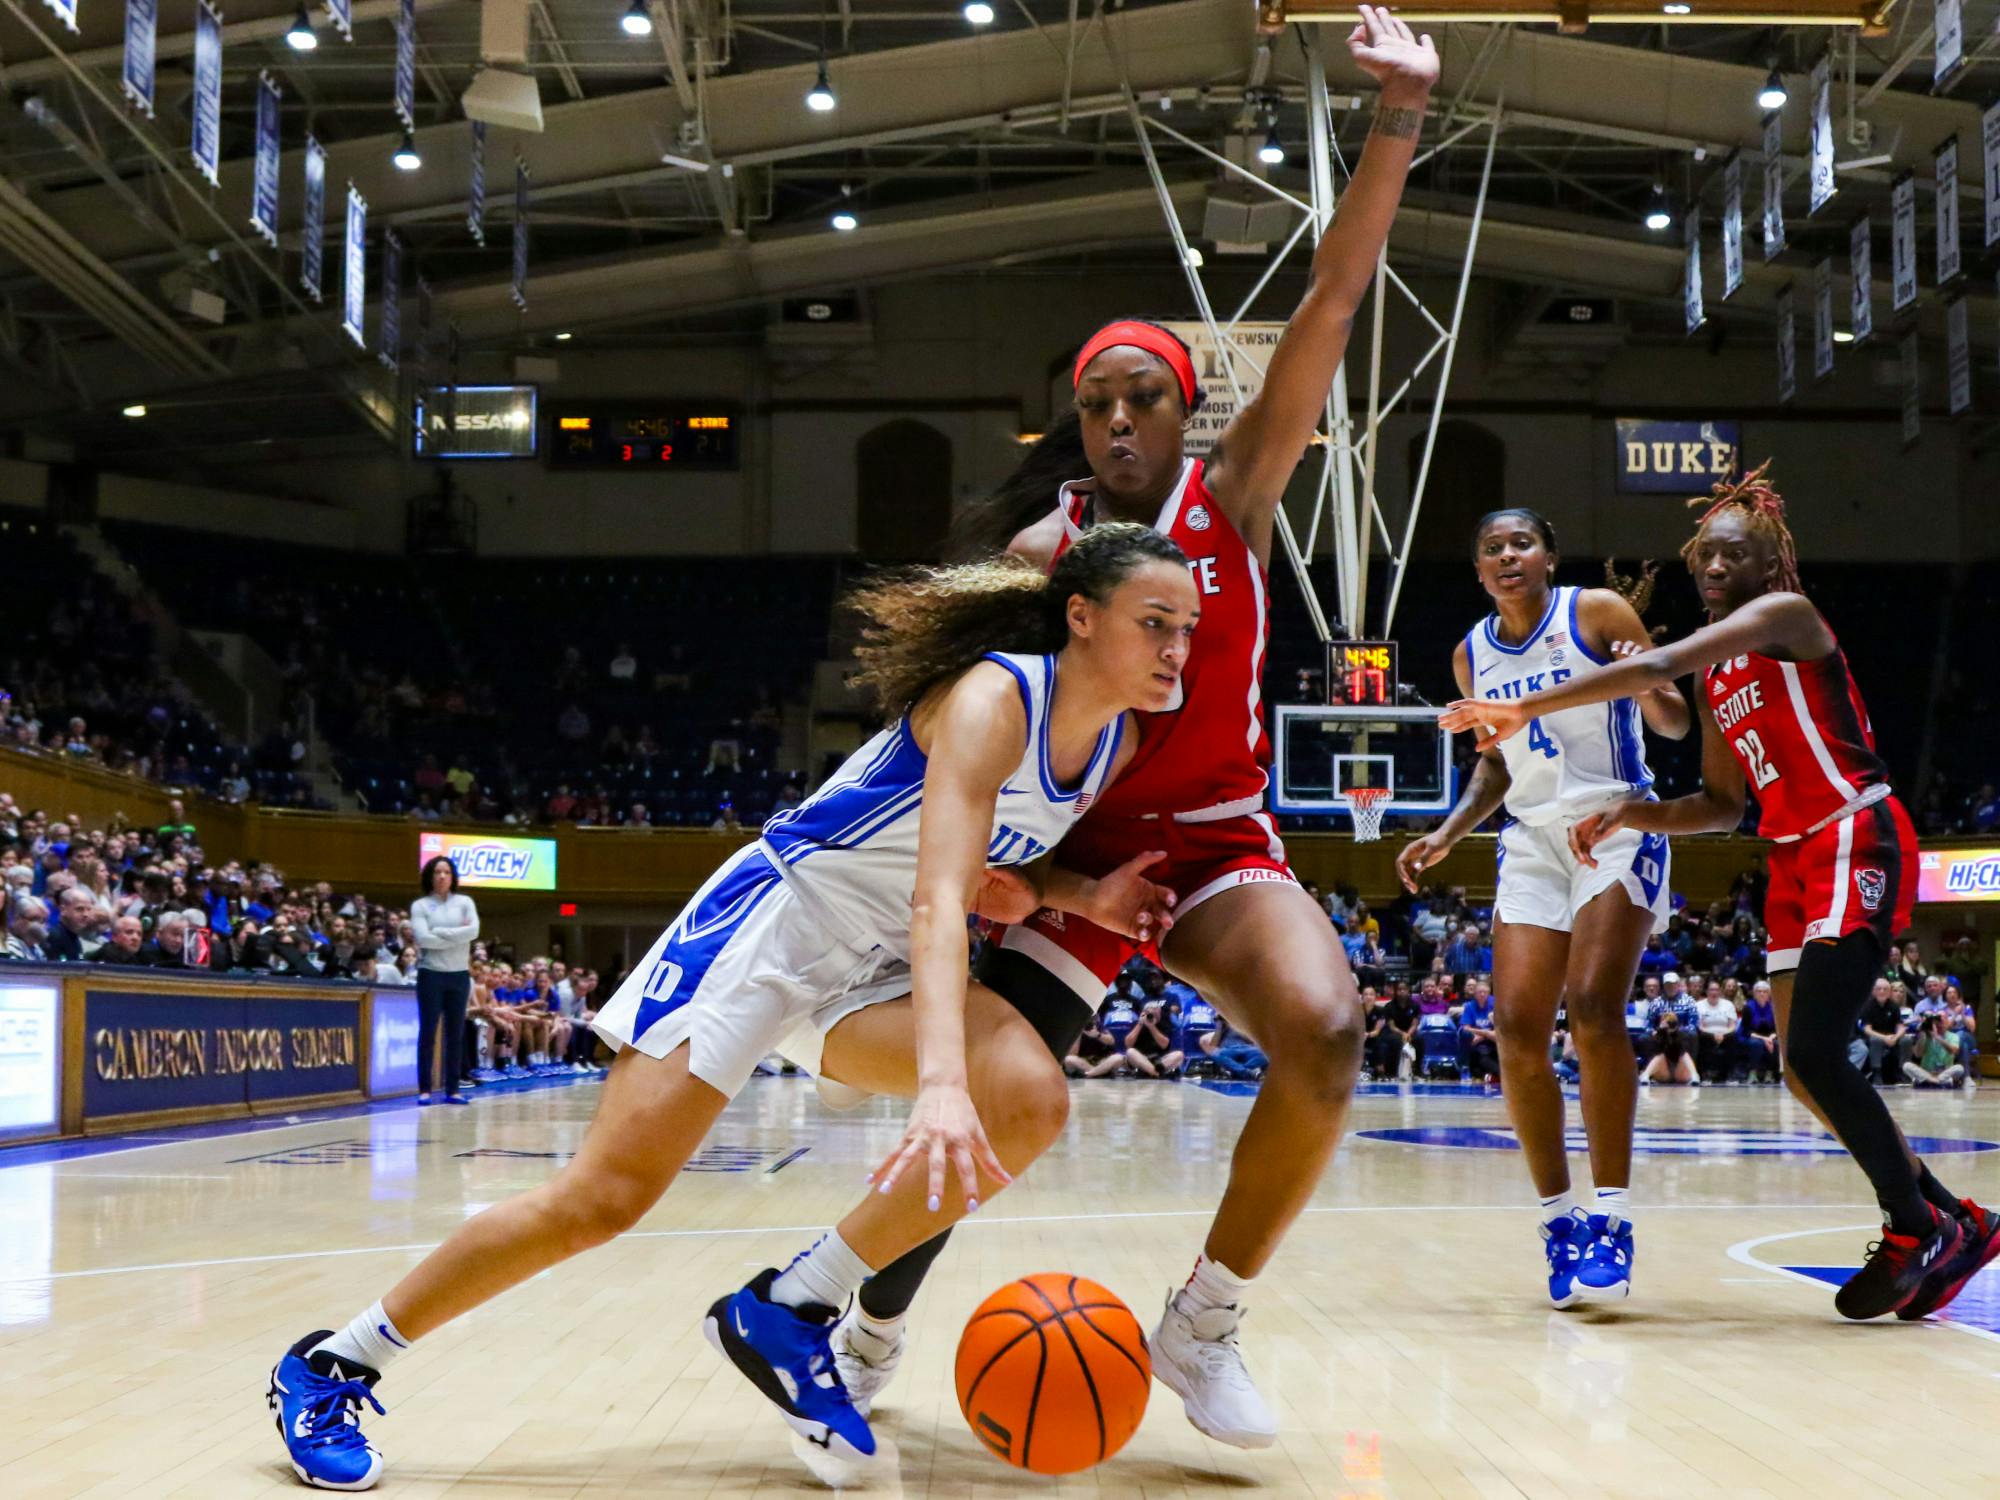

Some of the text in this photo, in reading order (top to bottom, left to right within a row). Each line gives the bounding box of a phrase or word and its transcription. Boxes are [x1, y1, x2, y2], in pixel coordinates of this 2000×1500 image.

[431, 412, 529, 430] NSSA
[1200, 402, 1234, 414] MOST
[622, 444, 633, 461] 3
[661, 444, 672, 461] 2
[1626, 441, 1731, 473] DUKE
[1345, 647, 1390, 669] 4:46
[1351, 669, 1385, 704] 17
[1719, 680, 1764, 729] STATE
[1528, 716, 1559, 759] 4
[1734, 729, 1780, 791] 22
[1641, 855, 1660, 887] D
[643, 960, 684, 1003] D
[95, 1028, 207, 1080] CAMERON
[215, 1027, 284, 1075] INDOOR
[291, 1027, 355, 1068] STADIUM
